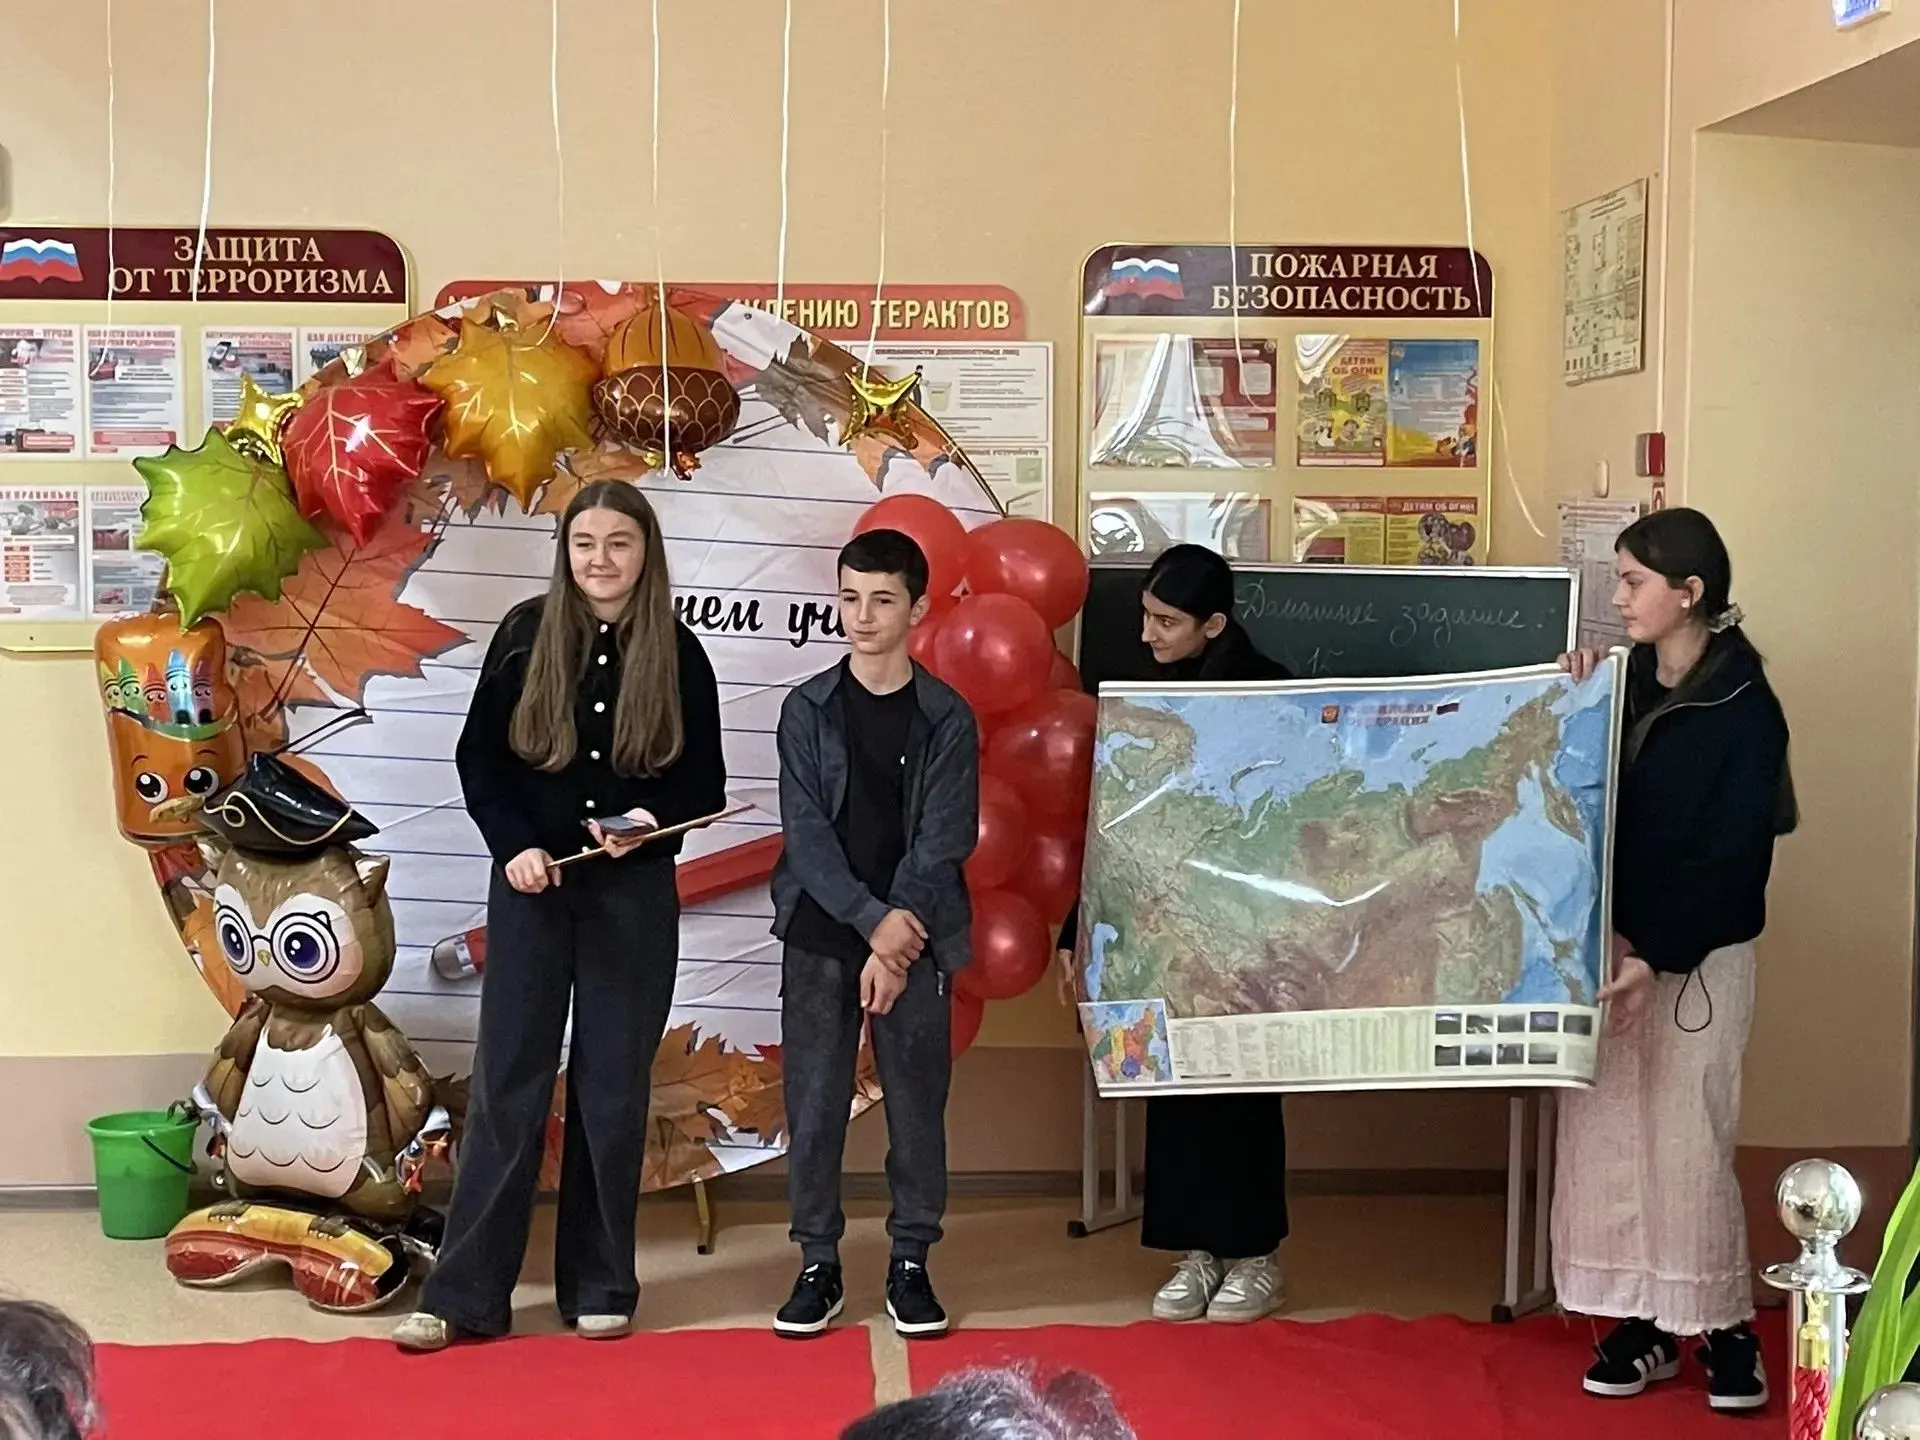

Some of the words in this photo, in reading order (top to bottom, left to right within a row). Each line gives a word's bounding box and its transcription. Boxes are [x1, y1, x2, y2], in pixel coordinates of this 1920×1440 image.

[174, 236, 324, 268] ЗАЩИТА
[1249, 252, 1439, 280] ПОЖАРНАЯ
[111, 267, 154, 293] ОТ
[163, 267, 394, 295] ТЕРРОРИЗМА
[1210, 284, 1472, 312] БЕЗОПАСНОСТЬ
[870, 299, 1011, 330] ТЕРАКТОВ
